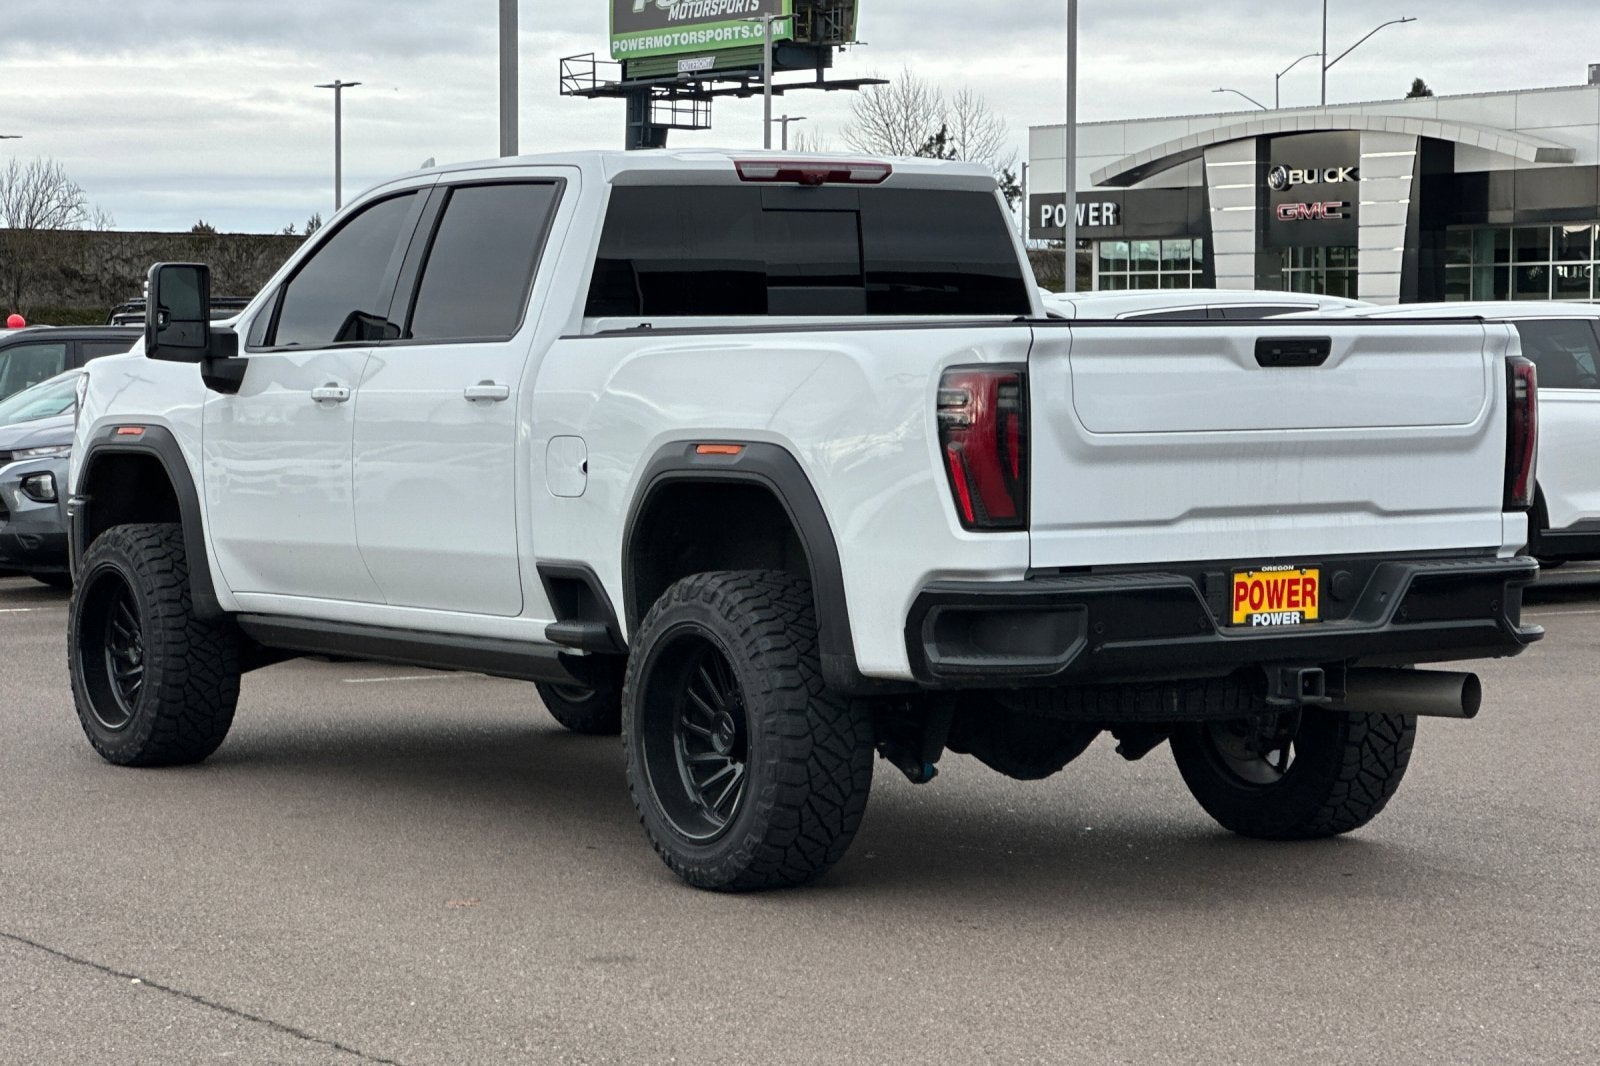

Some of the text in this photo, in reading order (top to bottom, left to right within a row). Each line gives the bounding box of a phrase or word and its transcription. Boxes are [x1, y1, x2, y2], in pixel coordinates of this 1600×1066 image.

[668, 0, 759, 21] MOTORSPORTS
[612, 22, 784, 52] POWERMOTORSPORTS.CM
[1288, 166, 1354, 185] BUICK
[1277, 201, 1343, 221] GMC
[1235, 578, 1316, 611] POWER
[1252, 612, 1300, 626] POWER
